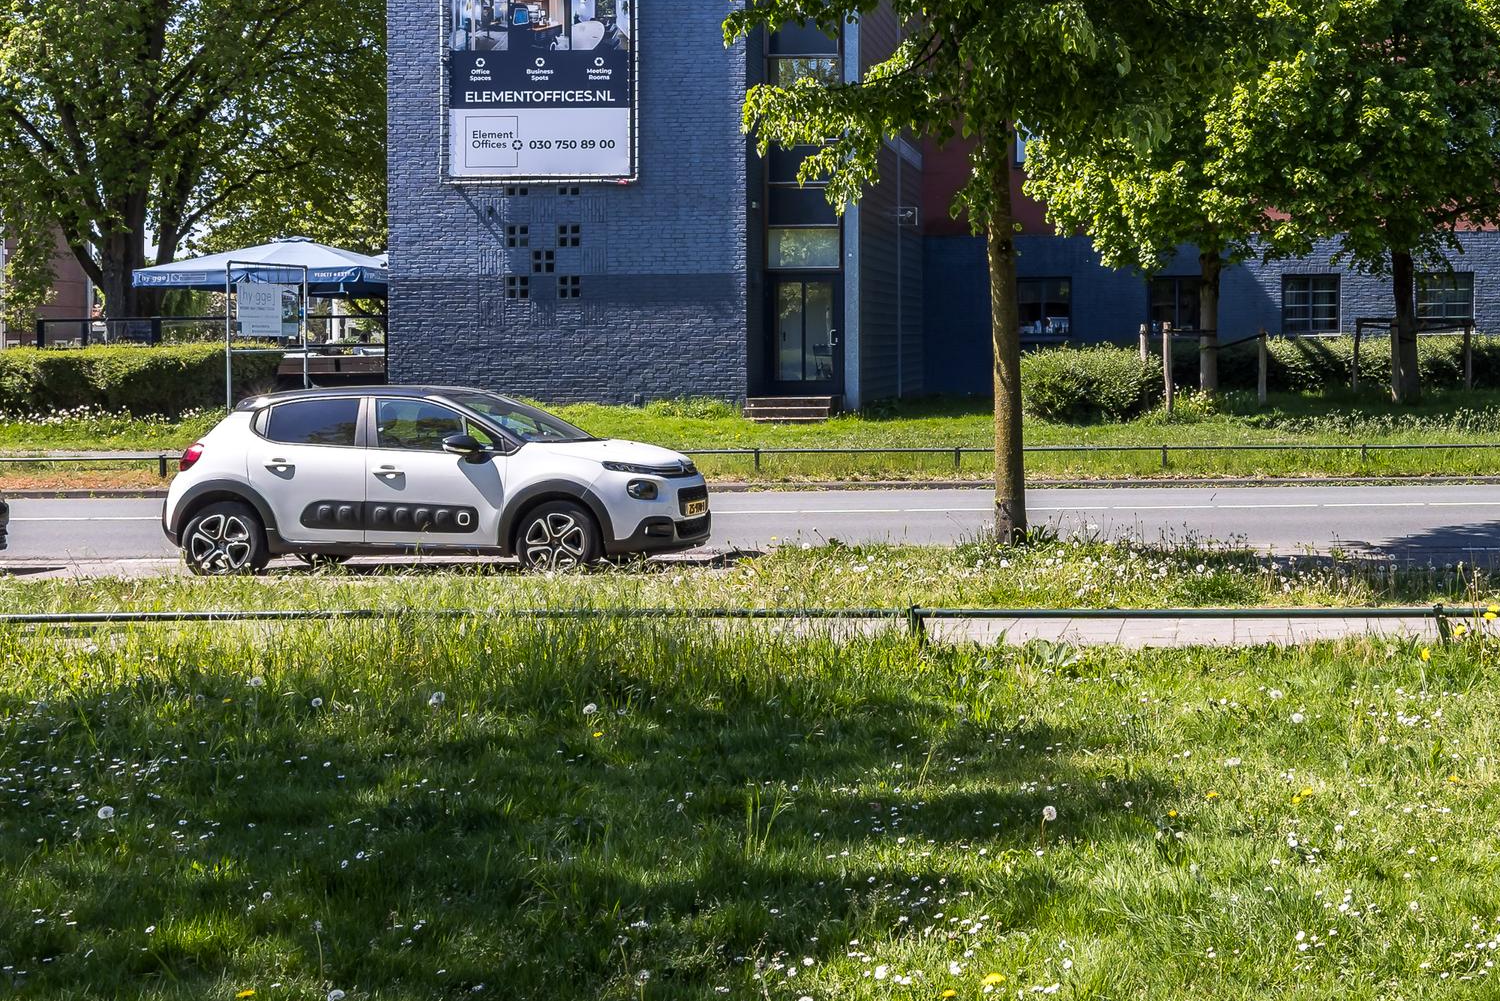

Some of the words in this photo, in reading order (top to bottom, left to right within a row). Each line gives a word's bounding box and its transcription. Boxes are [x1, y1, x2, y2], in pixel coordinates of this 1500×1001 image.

[465, 90, 616, 103] ELEMENTOFFICES.NL
[472, 131, 513, 139] Element
[472, 140, 507, 149] Offices
[529, 140, 551, 150] 030
[555, 140, 577, 150] 750
[581, 140, 596, 149] 89
[599, 139, 616, 149] 00
